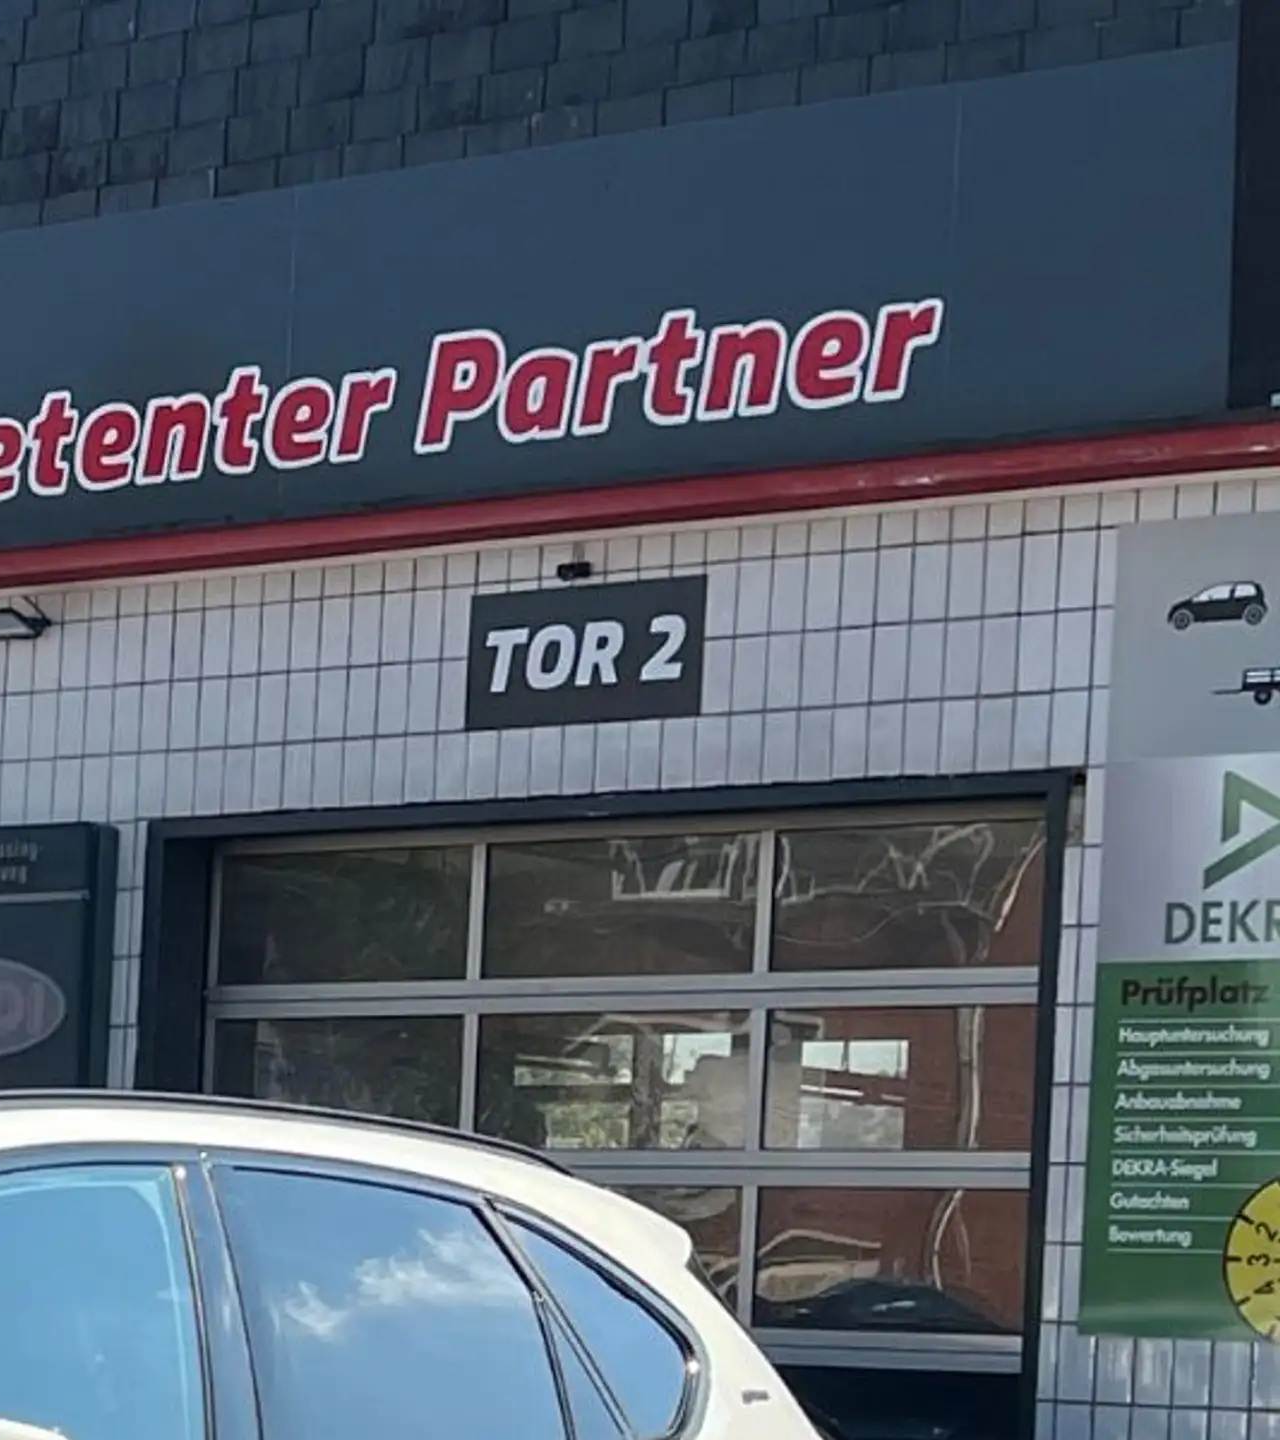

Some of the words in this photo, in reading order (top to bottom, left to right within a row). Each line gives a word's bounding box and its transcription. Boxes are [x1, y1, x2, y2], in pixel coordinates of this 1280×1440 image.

[413, 297, 944, 455] Partner
[485, 619, 626, 694] TOR
[640, 612, 688, 682] 2
[1120, 974, 1270, 1013] Prüfplatz
[1109, 1191, 1190, 1209] Gutachten
[1108, 1225, 1192, 1248] Bewertung
